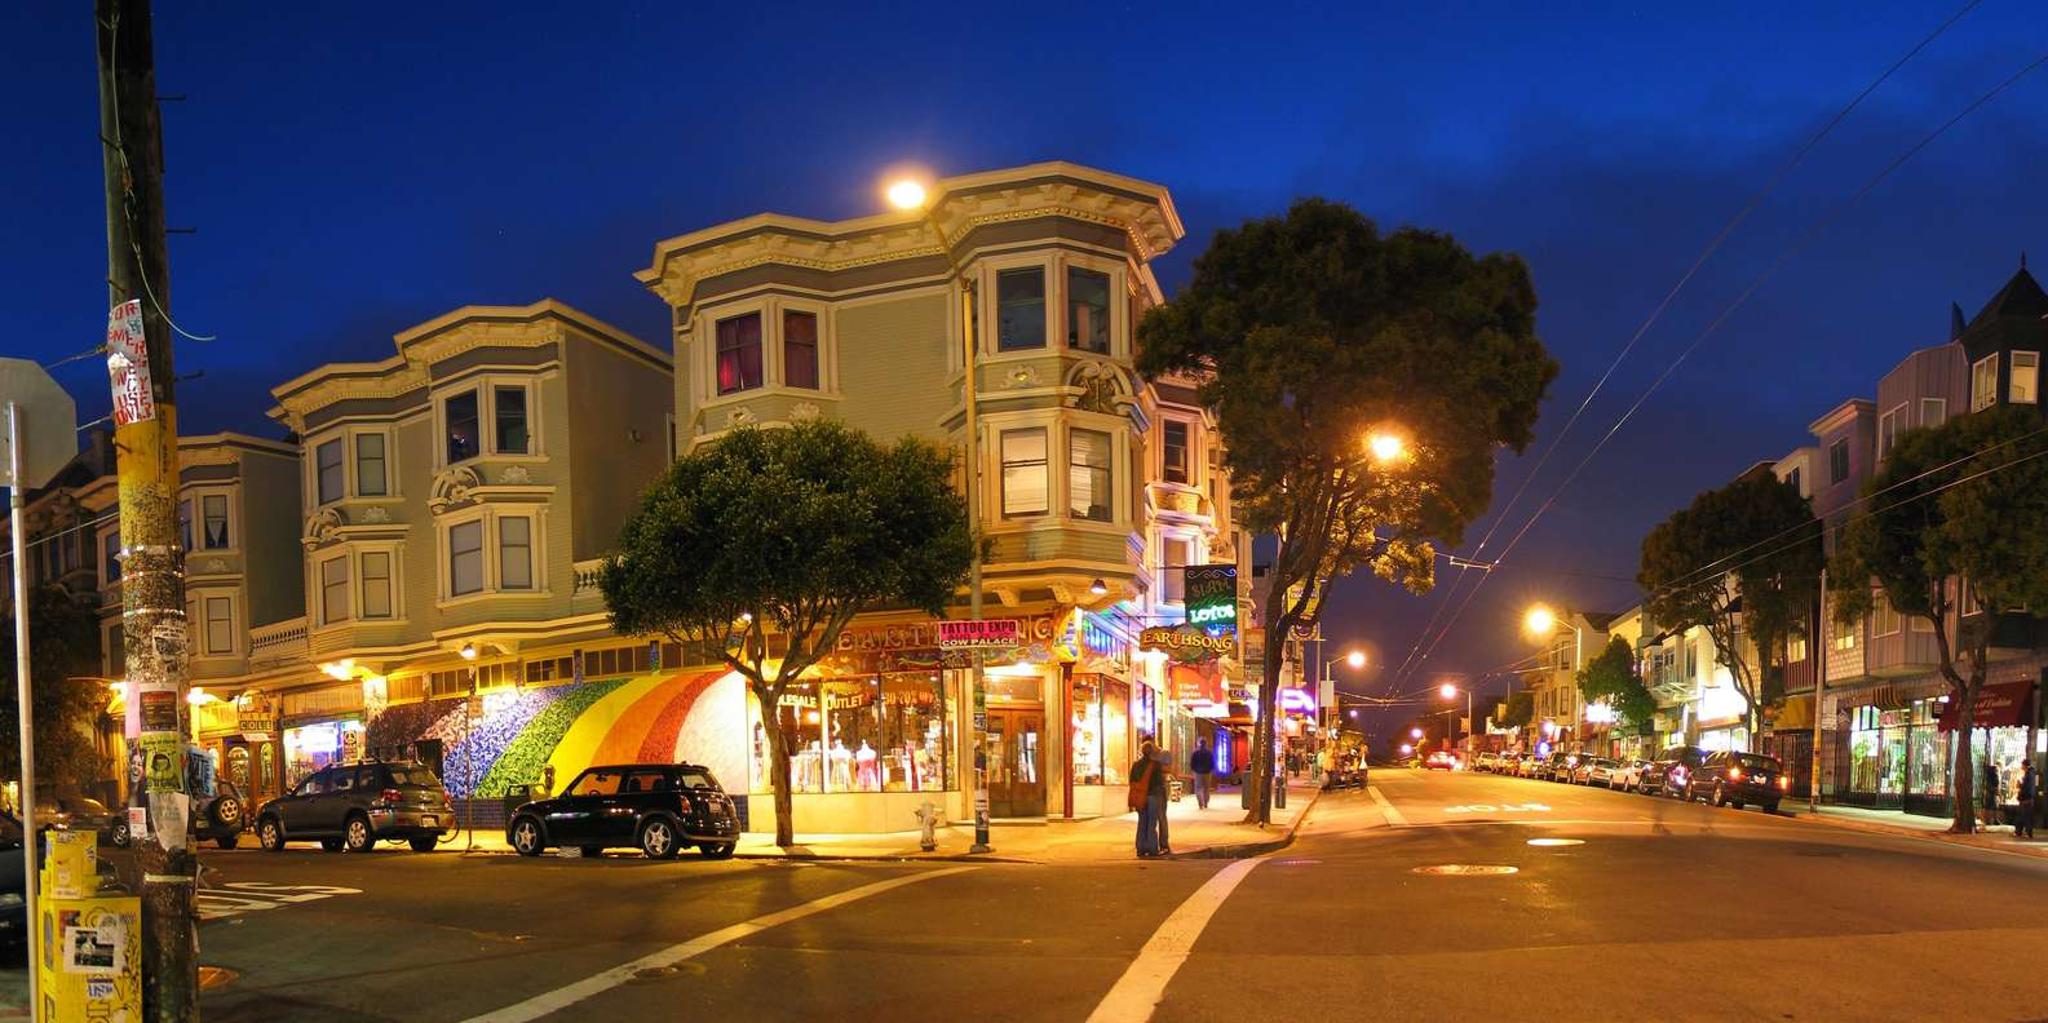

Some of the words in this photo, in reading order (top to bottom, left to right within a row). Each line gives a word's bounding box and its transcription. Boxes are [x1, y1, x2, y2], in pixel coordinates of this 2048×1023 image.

[941, 623, 984, 634] TATTOO
[988, 621, 1016, 632] EXPO
[942, 639, 969, 647] COW
[971, 637, 1015, 645] PALACE
[1143, 631, 1233, 652] EARTHSONG
[826, 694, 863, 710] OUTLET
